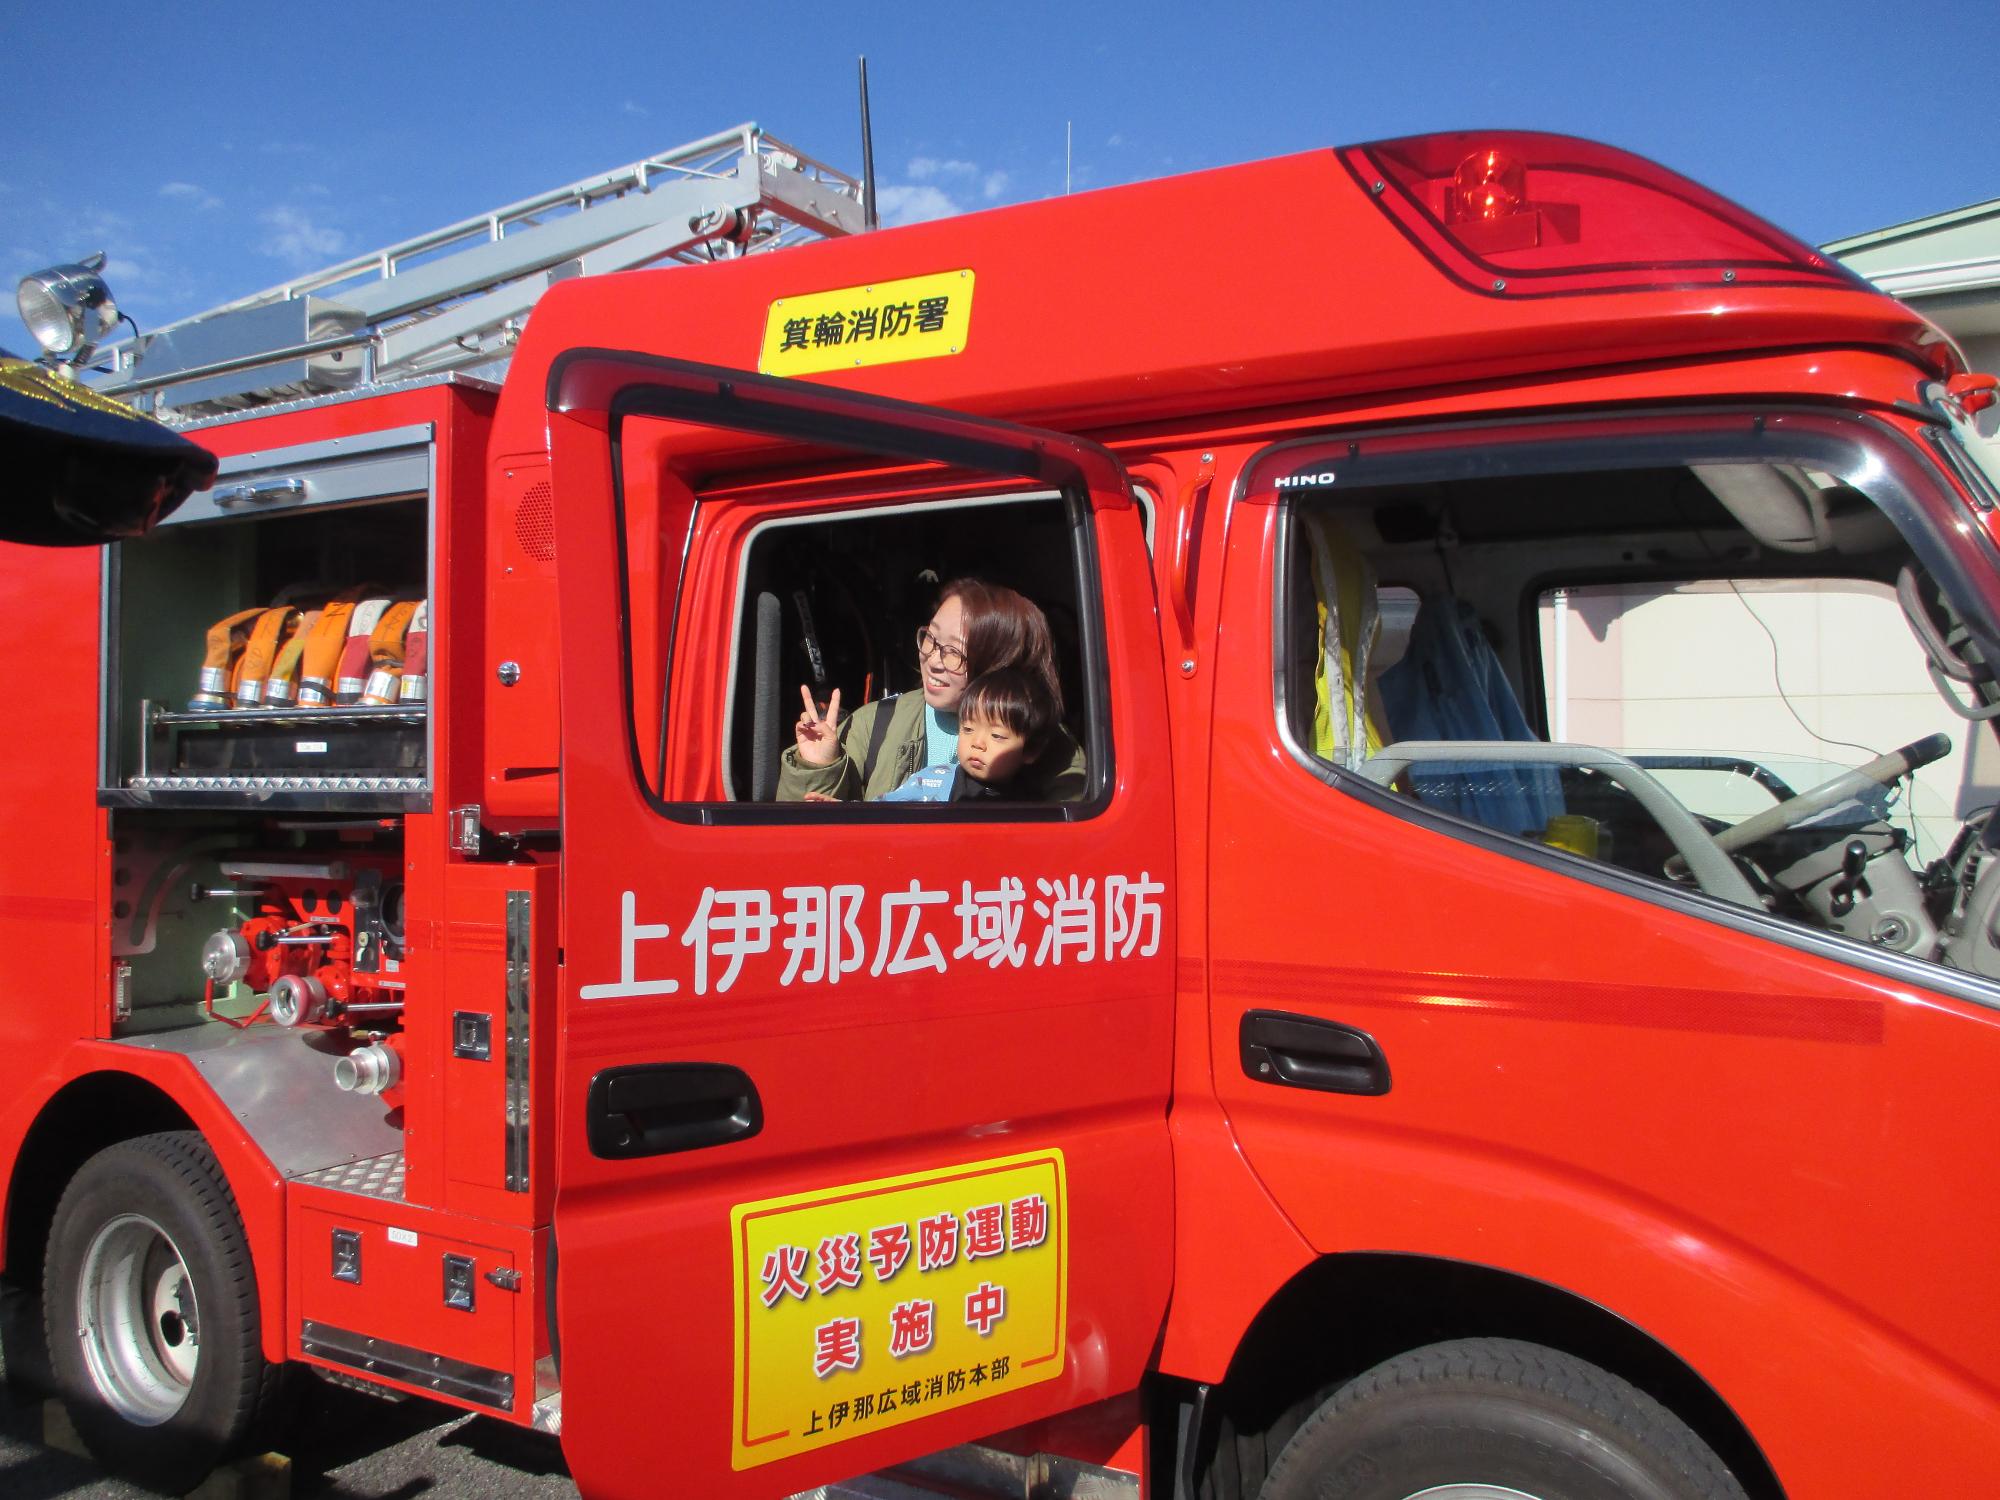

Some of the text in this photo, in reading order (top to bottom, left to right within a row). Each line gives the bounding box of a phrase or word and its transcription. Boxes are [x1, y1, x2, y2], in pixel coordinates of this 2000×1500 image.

[780, 296, 949, 353] 箕輪消防署
[1274, 472, 1335, 488] HINO
[580, 871, 1165, 1000] 上伊那広域消防
[760, 1194, 1049, 1306] 火災予防運動
[813, 1281, 1004, 1377] 実施中
[802, 1356, 1010, 1437] 上伊那広域消防本部
